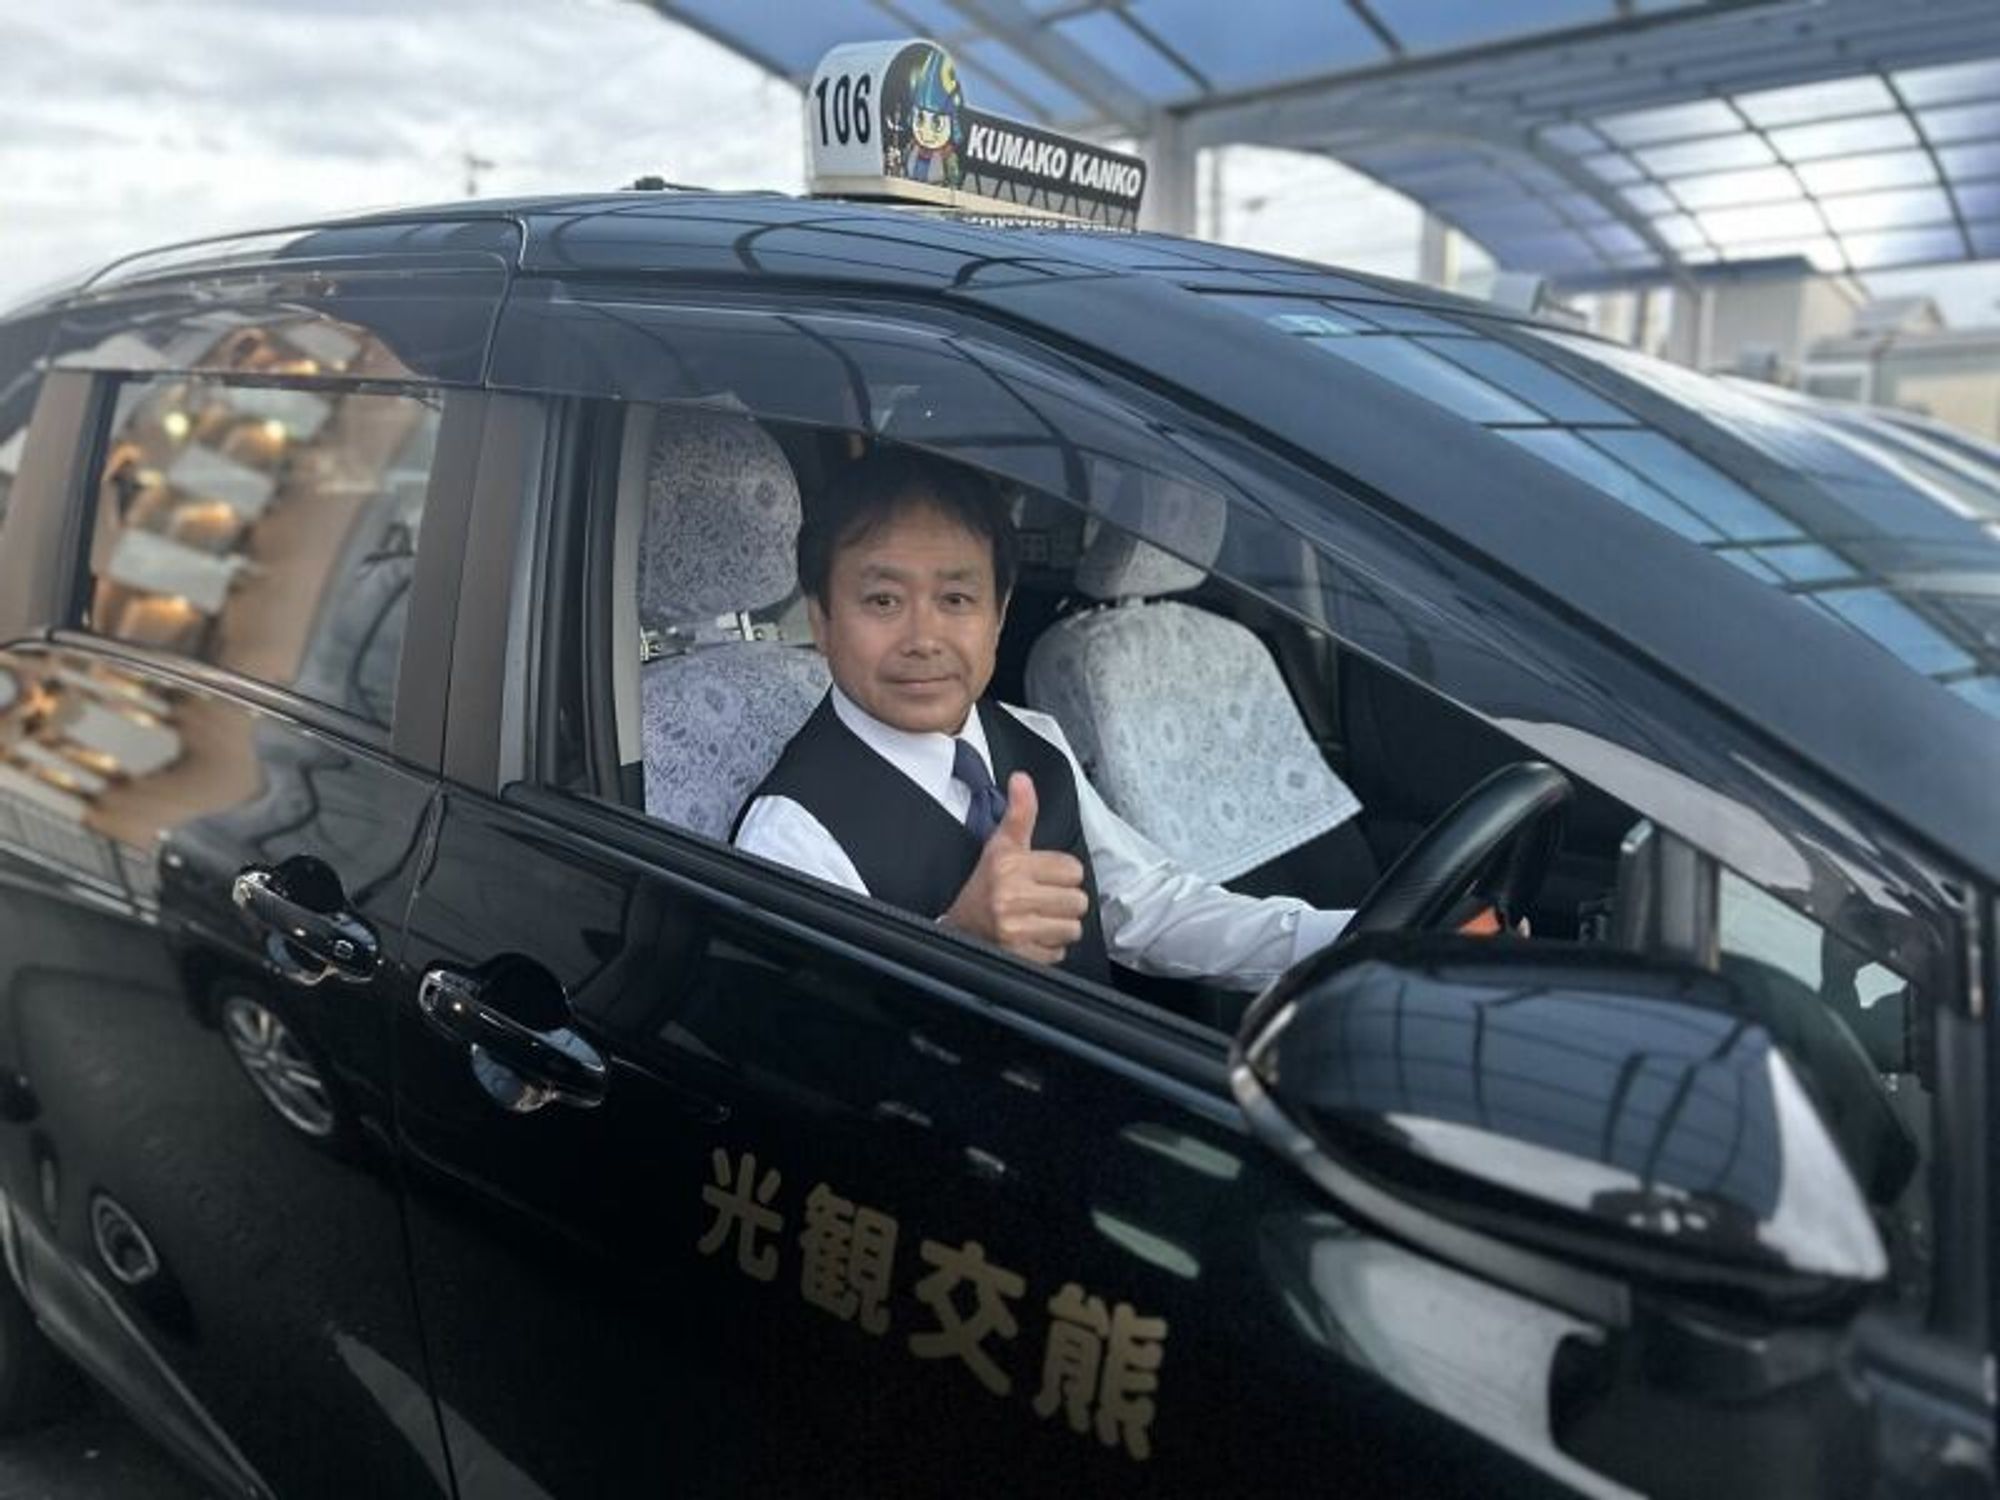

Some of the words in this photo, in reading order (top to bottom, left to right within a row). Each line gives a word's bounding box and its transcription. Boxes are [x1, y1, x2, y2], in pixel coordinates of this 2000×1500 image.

[815, 74, 872, 146] 106
[967, 124, 1067, 179] KUMAKO
[1069, 150, 1142, 197] KANKO
